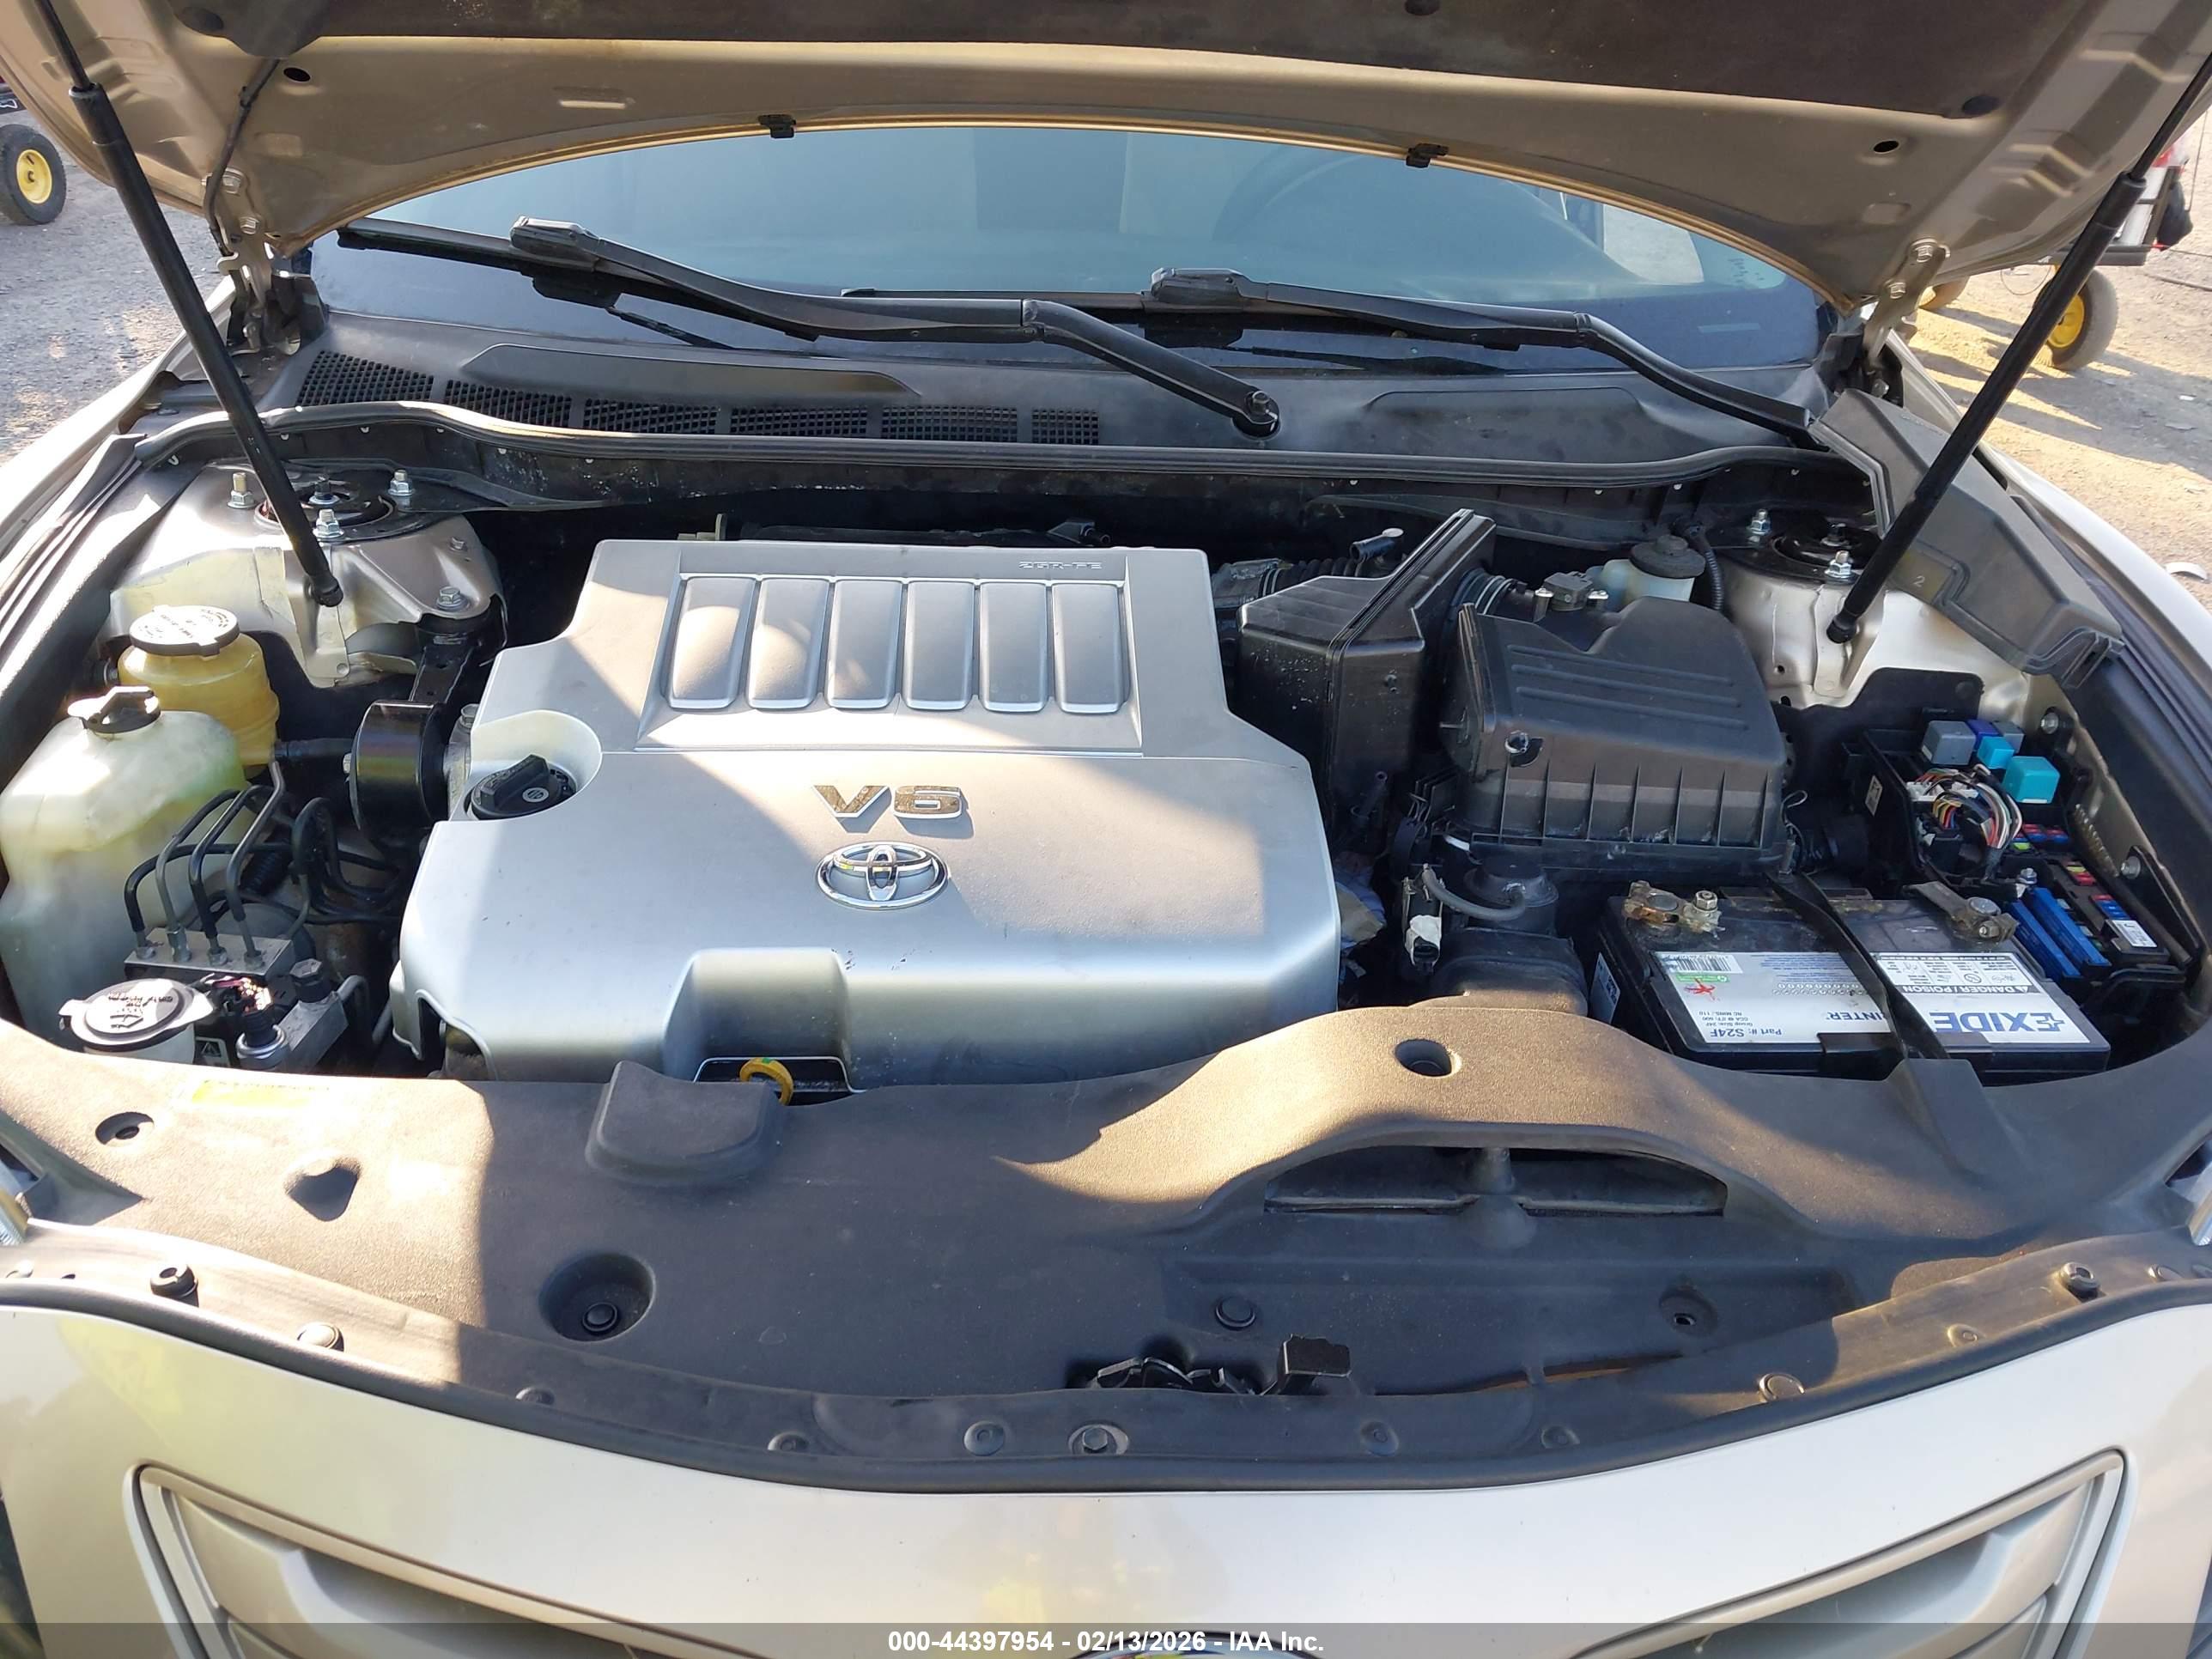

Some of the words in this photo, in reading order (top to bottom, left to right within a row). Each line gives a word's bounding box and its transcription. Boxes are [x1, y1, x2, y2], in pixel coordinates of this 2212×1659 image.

[1018, 561, 1103, 569] 2GR-FE
[812, 785, 963, 818] V6
[1903, 985, 1952, 994] POISON
[1960, 985, 2015, 994] DANGER
[1828, 1012, 1884, 1021] INTER
[1929, 1012, 2065, 1032] EXIDE
[1710, 1028, 1745, 1037] S24F
